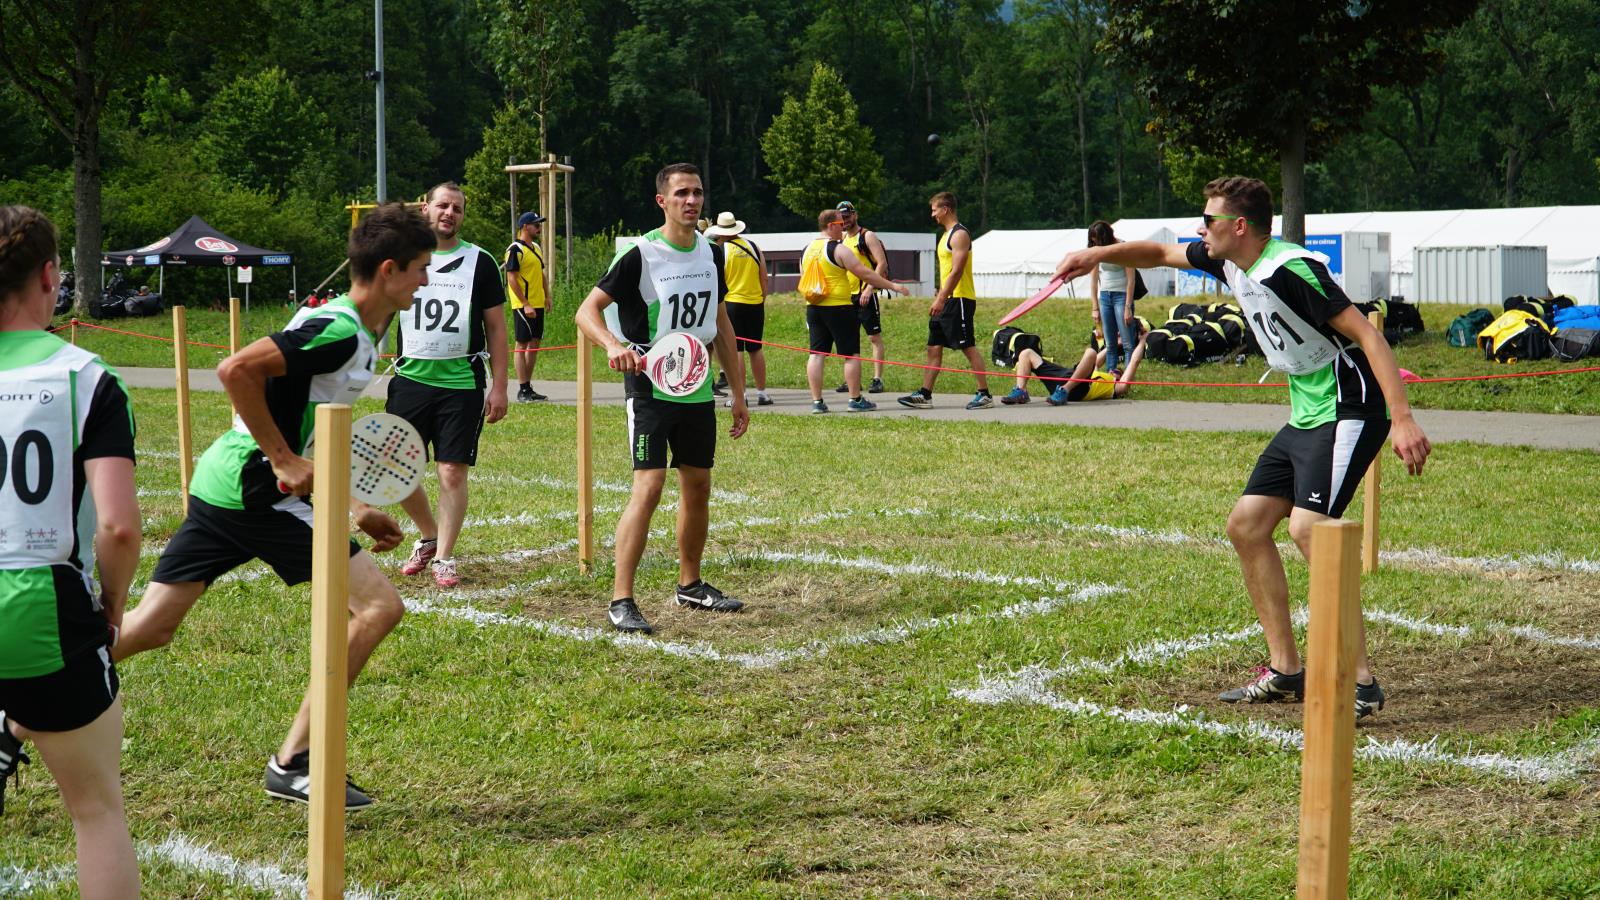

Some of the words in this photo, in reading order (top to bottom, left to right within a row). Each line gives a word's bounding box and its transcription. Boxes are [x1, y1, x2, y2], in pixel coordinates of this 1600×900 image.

[660, 273, 704, 282] DATASPORT
[411, 298, 460, 334] 192
[668, 291, 712, 330] 187
[1253, 312, 1304, 351] 191
[636, 434, 645, 461] dirim
[0, 429, 54, 505] 0
